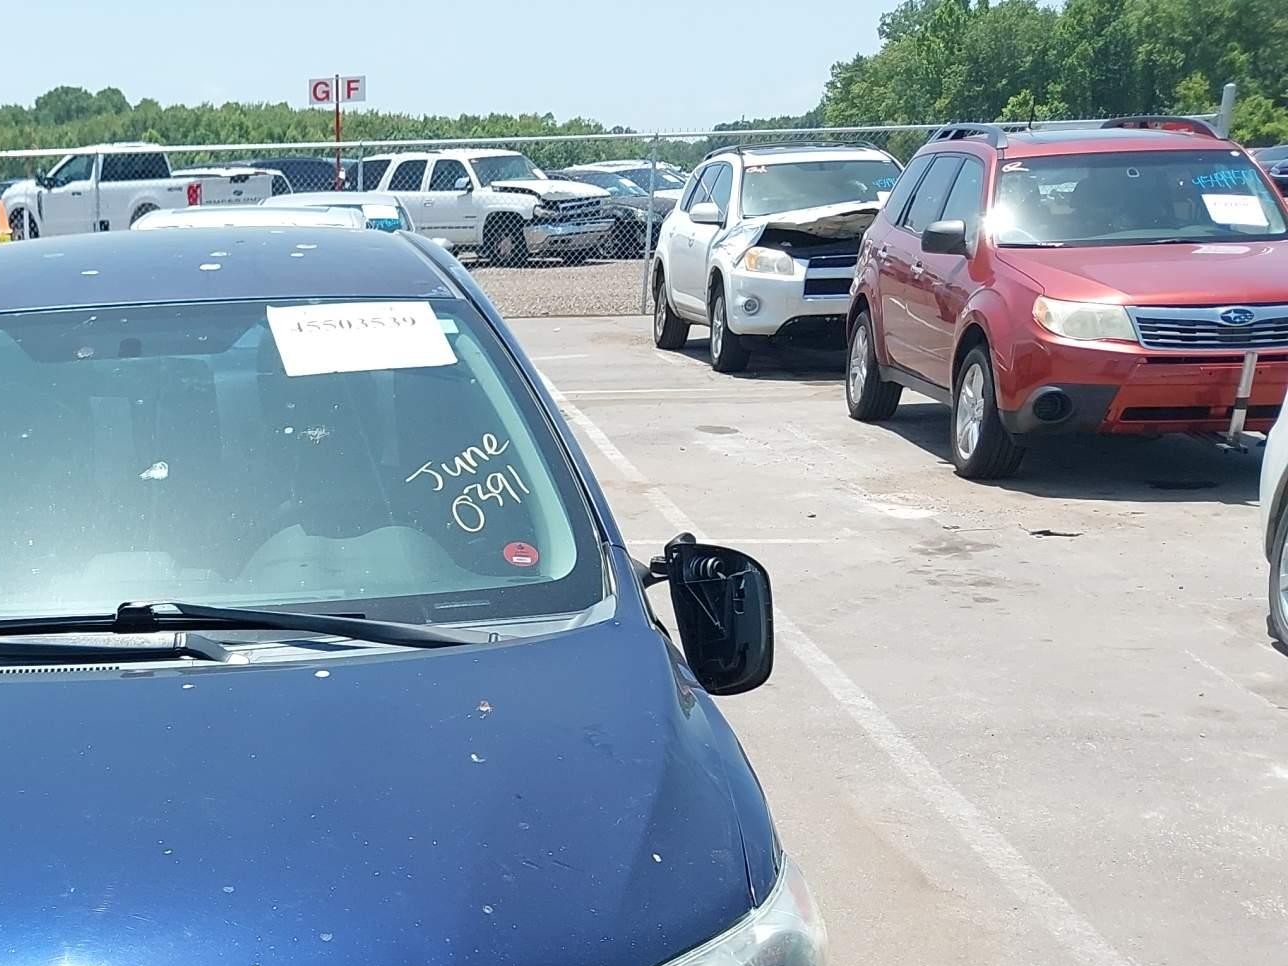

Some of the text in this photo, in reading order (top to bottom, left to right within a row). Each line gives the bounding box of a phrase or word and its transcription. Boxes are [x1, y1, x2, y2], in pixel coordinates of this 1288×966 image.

[312, 81, 330, 102] G
[347, 79, 360, 99] F
[291, 316, 416, 333] 45503539
[405, 432, 510, 491] June
[452, 464, 530, 532] 0391
